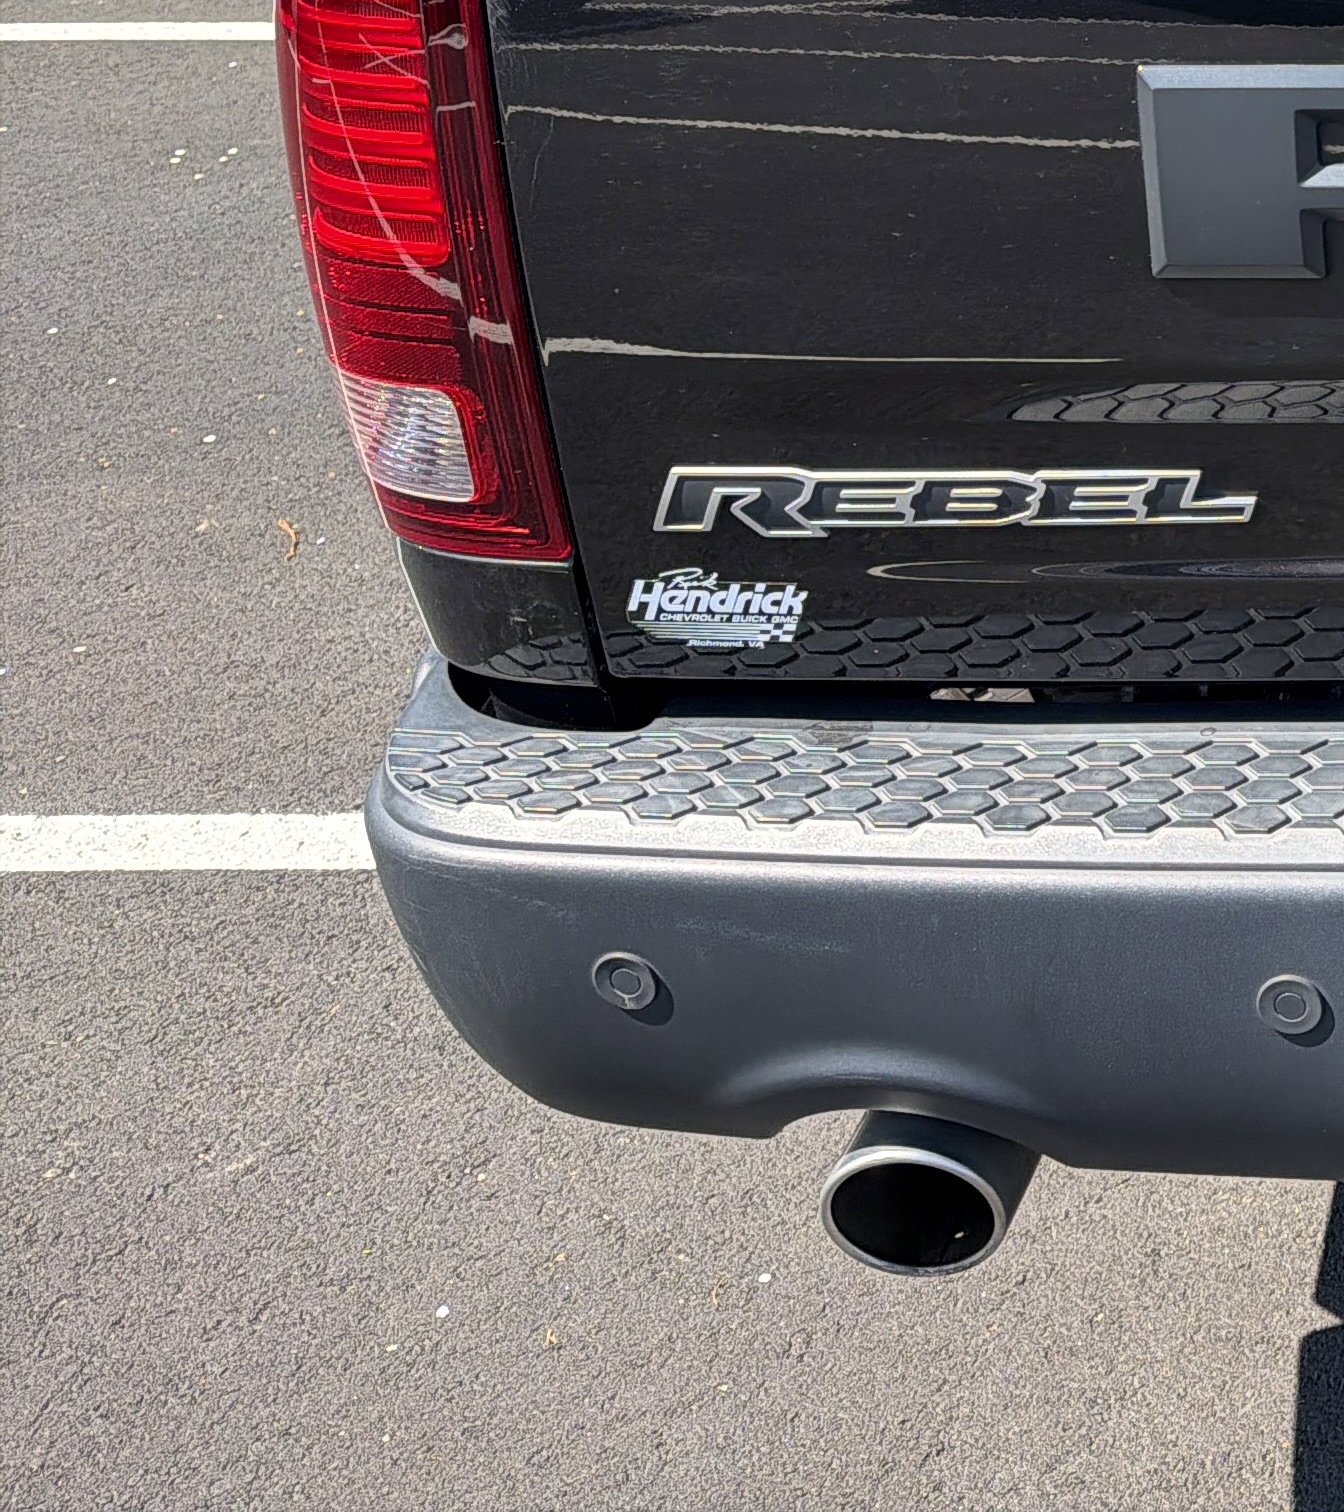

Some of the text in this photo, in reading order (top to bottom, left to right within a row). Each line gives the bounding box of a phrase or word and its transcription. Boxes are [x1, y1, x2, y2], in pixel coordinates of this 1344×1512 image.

[653, 464, 1259, 538] REBEL
[658, 567, 720, 590] Rick
[626, 579, 809, 620] Hendrick
[659, 613, 800, 624] CHEVROLET BUICK GMC
